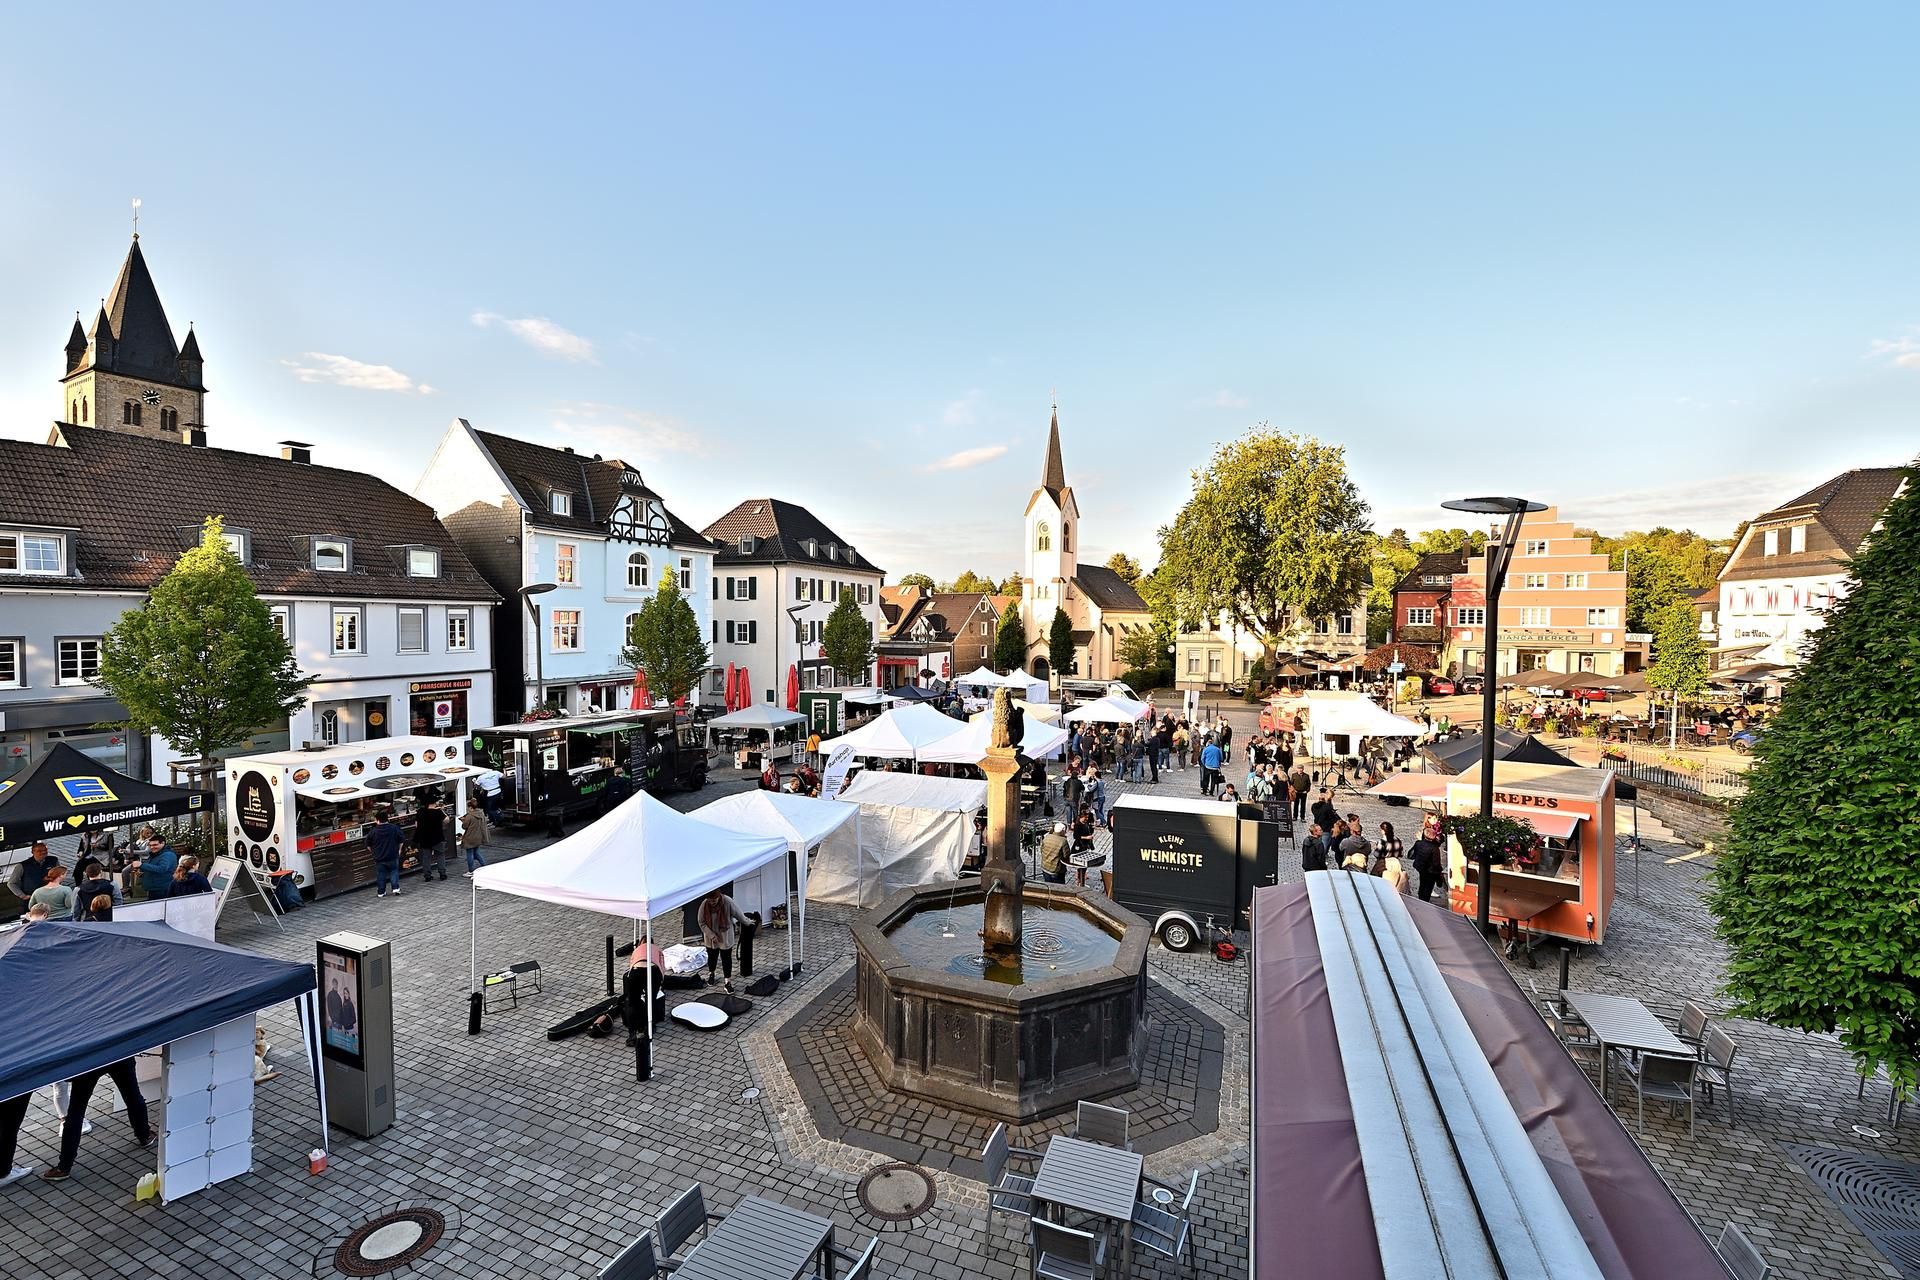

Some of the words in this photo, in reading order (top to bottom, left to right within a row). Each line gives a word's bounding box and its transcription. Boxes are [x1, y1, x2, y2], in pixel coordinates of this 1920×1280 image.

[1494, 792, 1558, 808] REPES
[43, 820, 65, 833] Wir
[87, 804, 159, 825] Lebensmittel.
[1158, 835, 1185, 845] KLEINE
[1140, 848, 1203, 867] WEINKISTE
